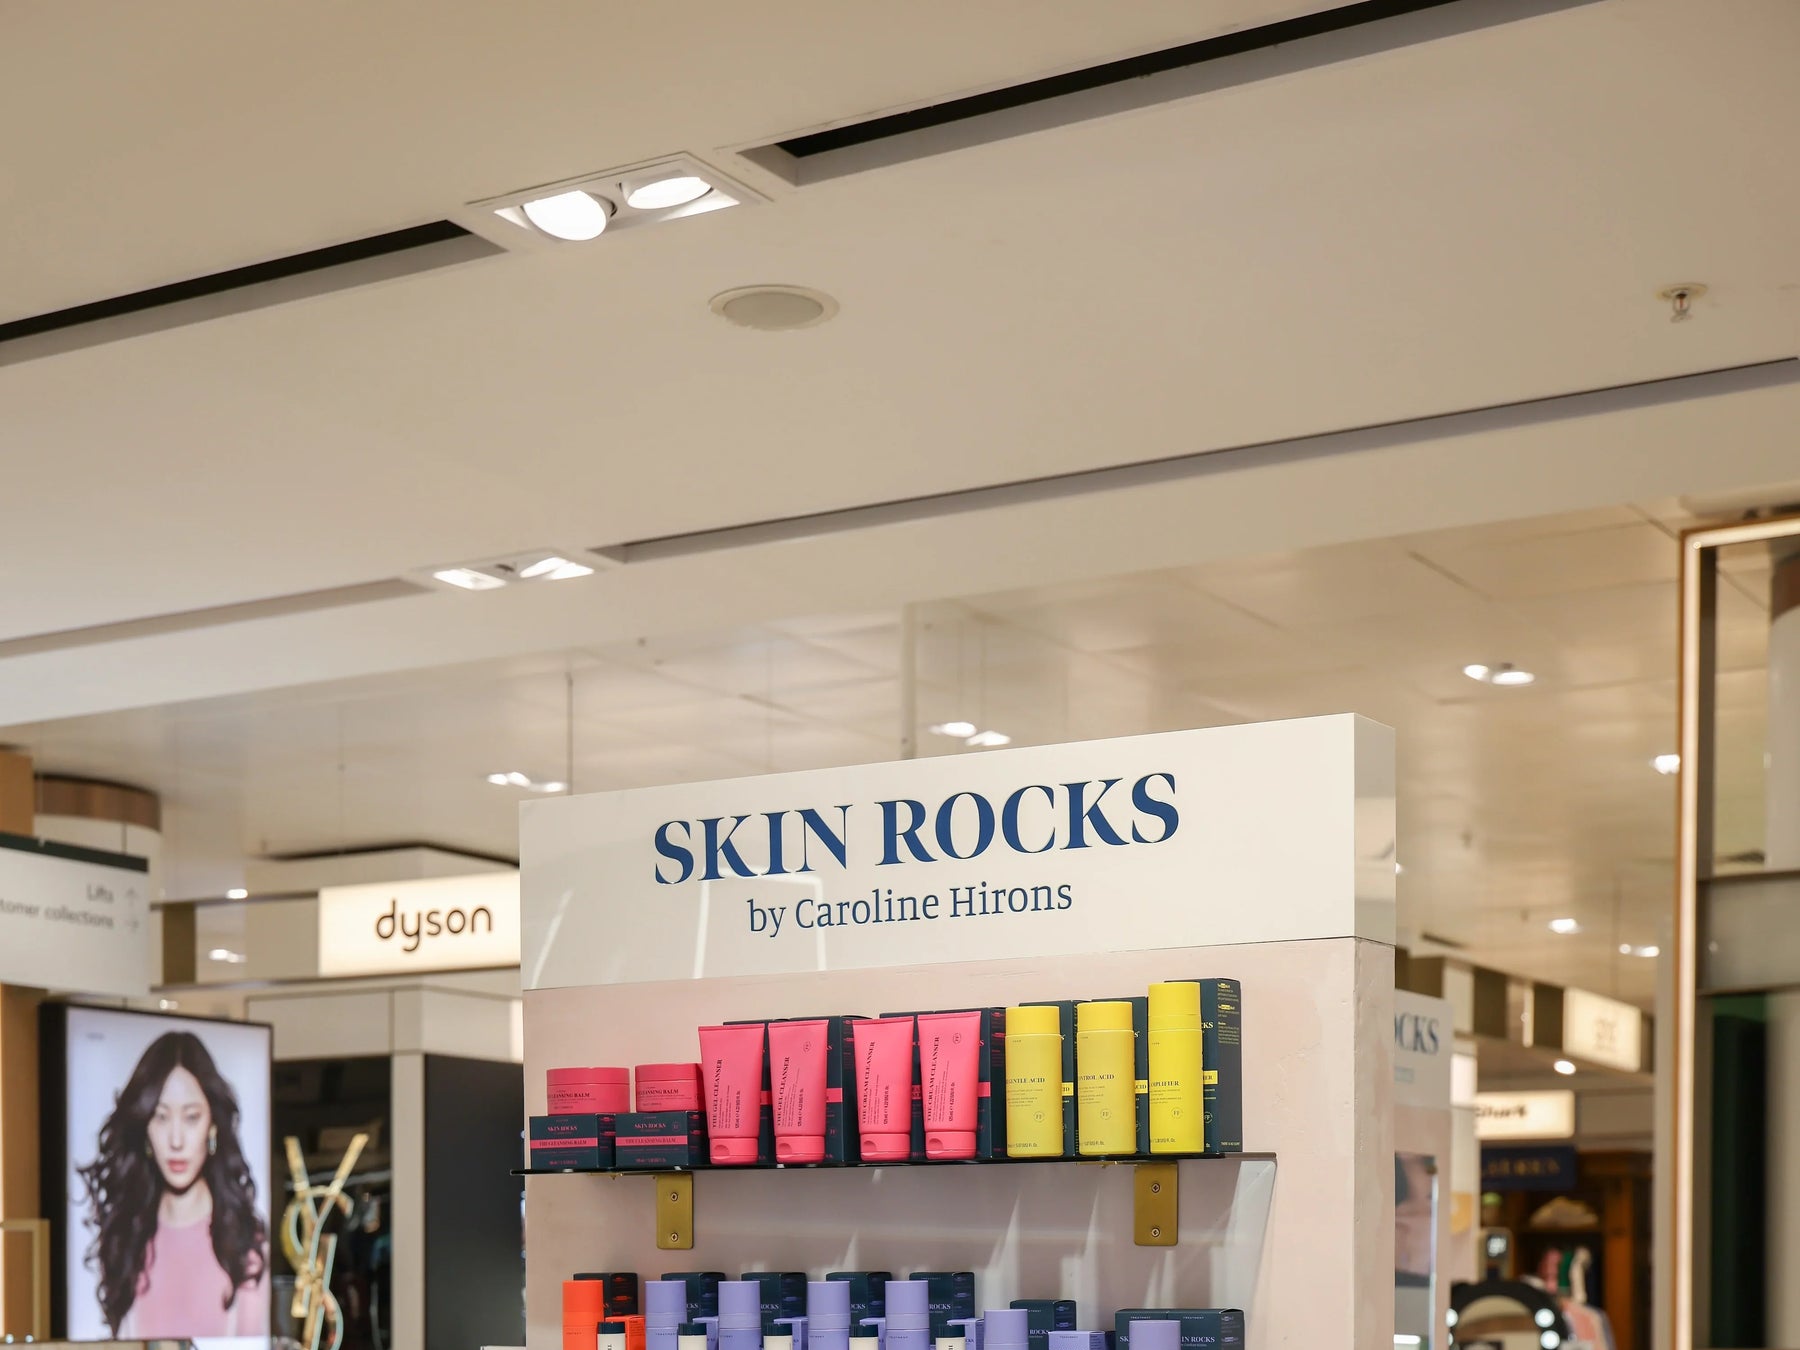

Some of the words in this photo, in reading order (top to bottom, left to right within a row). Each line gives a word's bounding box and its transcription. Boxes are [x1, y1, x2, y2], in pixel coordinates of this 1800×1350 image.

[653, 804, 853, 885] SKIN
[875, 772, 1179, 867] ROCKS
[44, 905, 114, 929] collections
[374, 899, 493, 953] dyson
[747, 899, 786, 938] by
[795, 889, 940, 929] Caroline
[949, 880, 1073, 918] Hirons
[779, 1057, 790, 1095] CLEANSER
[930, 1036, 939, 1076] CLEANSER
[713, 1059, 722, 1096] CLEANSER
